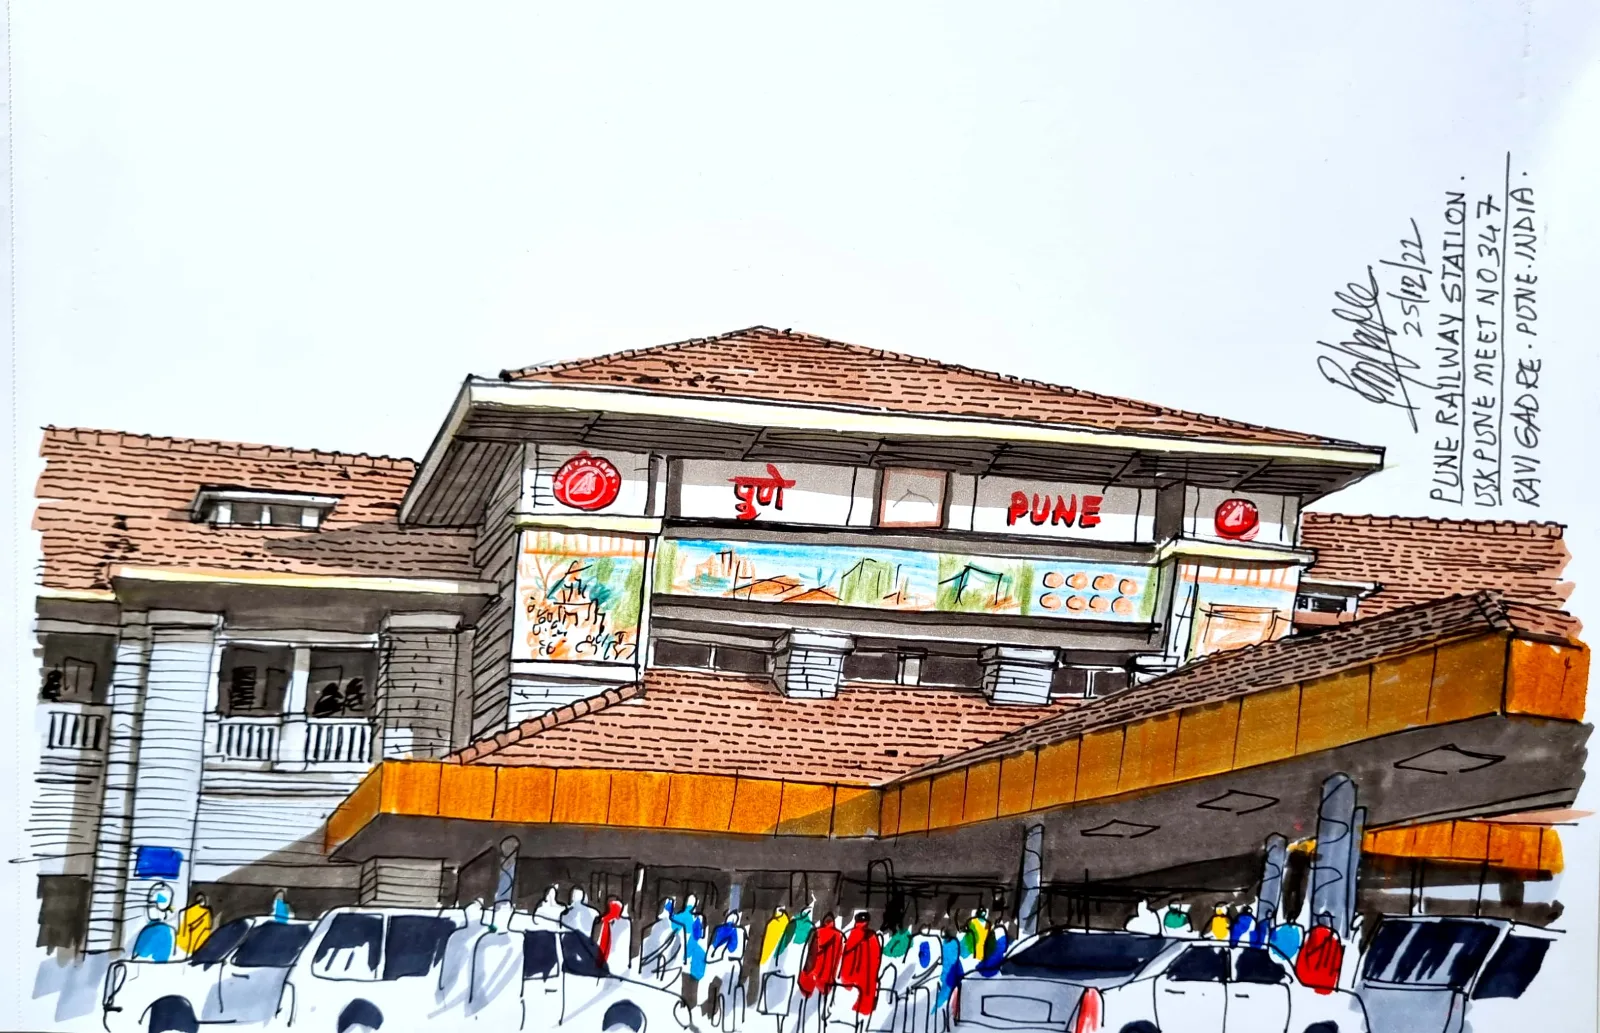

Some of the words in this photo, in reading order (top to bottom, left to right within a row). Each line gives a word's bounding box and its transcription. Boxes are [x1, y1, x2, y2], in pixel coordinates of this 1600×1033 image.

[1477, 194, 1500, 267] 347
[1379, 218, 1432, 337] 25/12/22
[1476, 269, 1499, 305] NO
[1435, 314, 1463, 426] RAILWAY
[1474, 315, 1496, 385] MEET
[1472, 396, 1496, 462] PUNE
[728, 463, 796, 520] पुणे
[1430, 437, 1462, 504] PUNE
[1511, 455, 1541, 507] RAVI
[1007, 490, 1103, 528] PUNE
